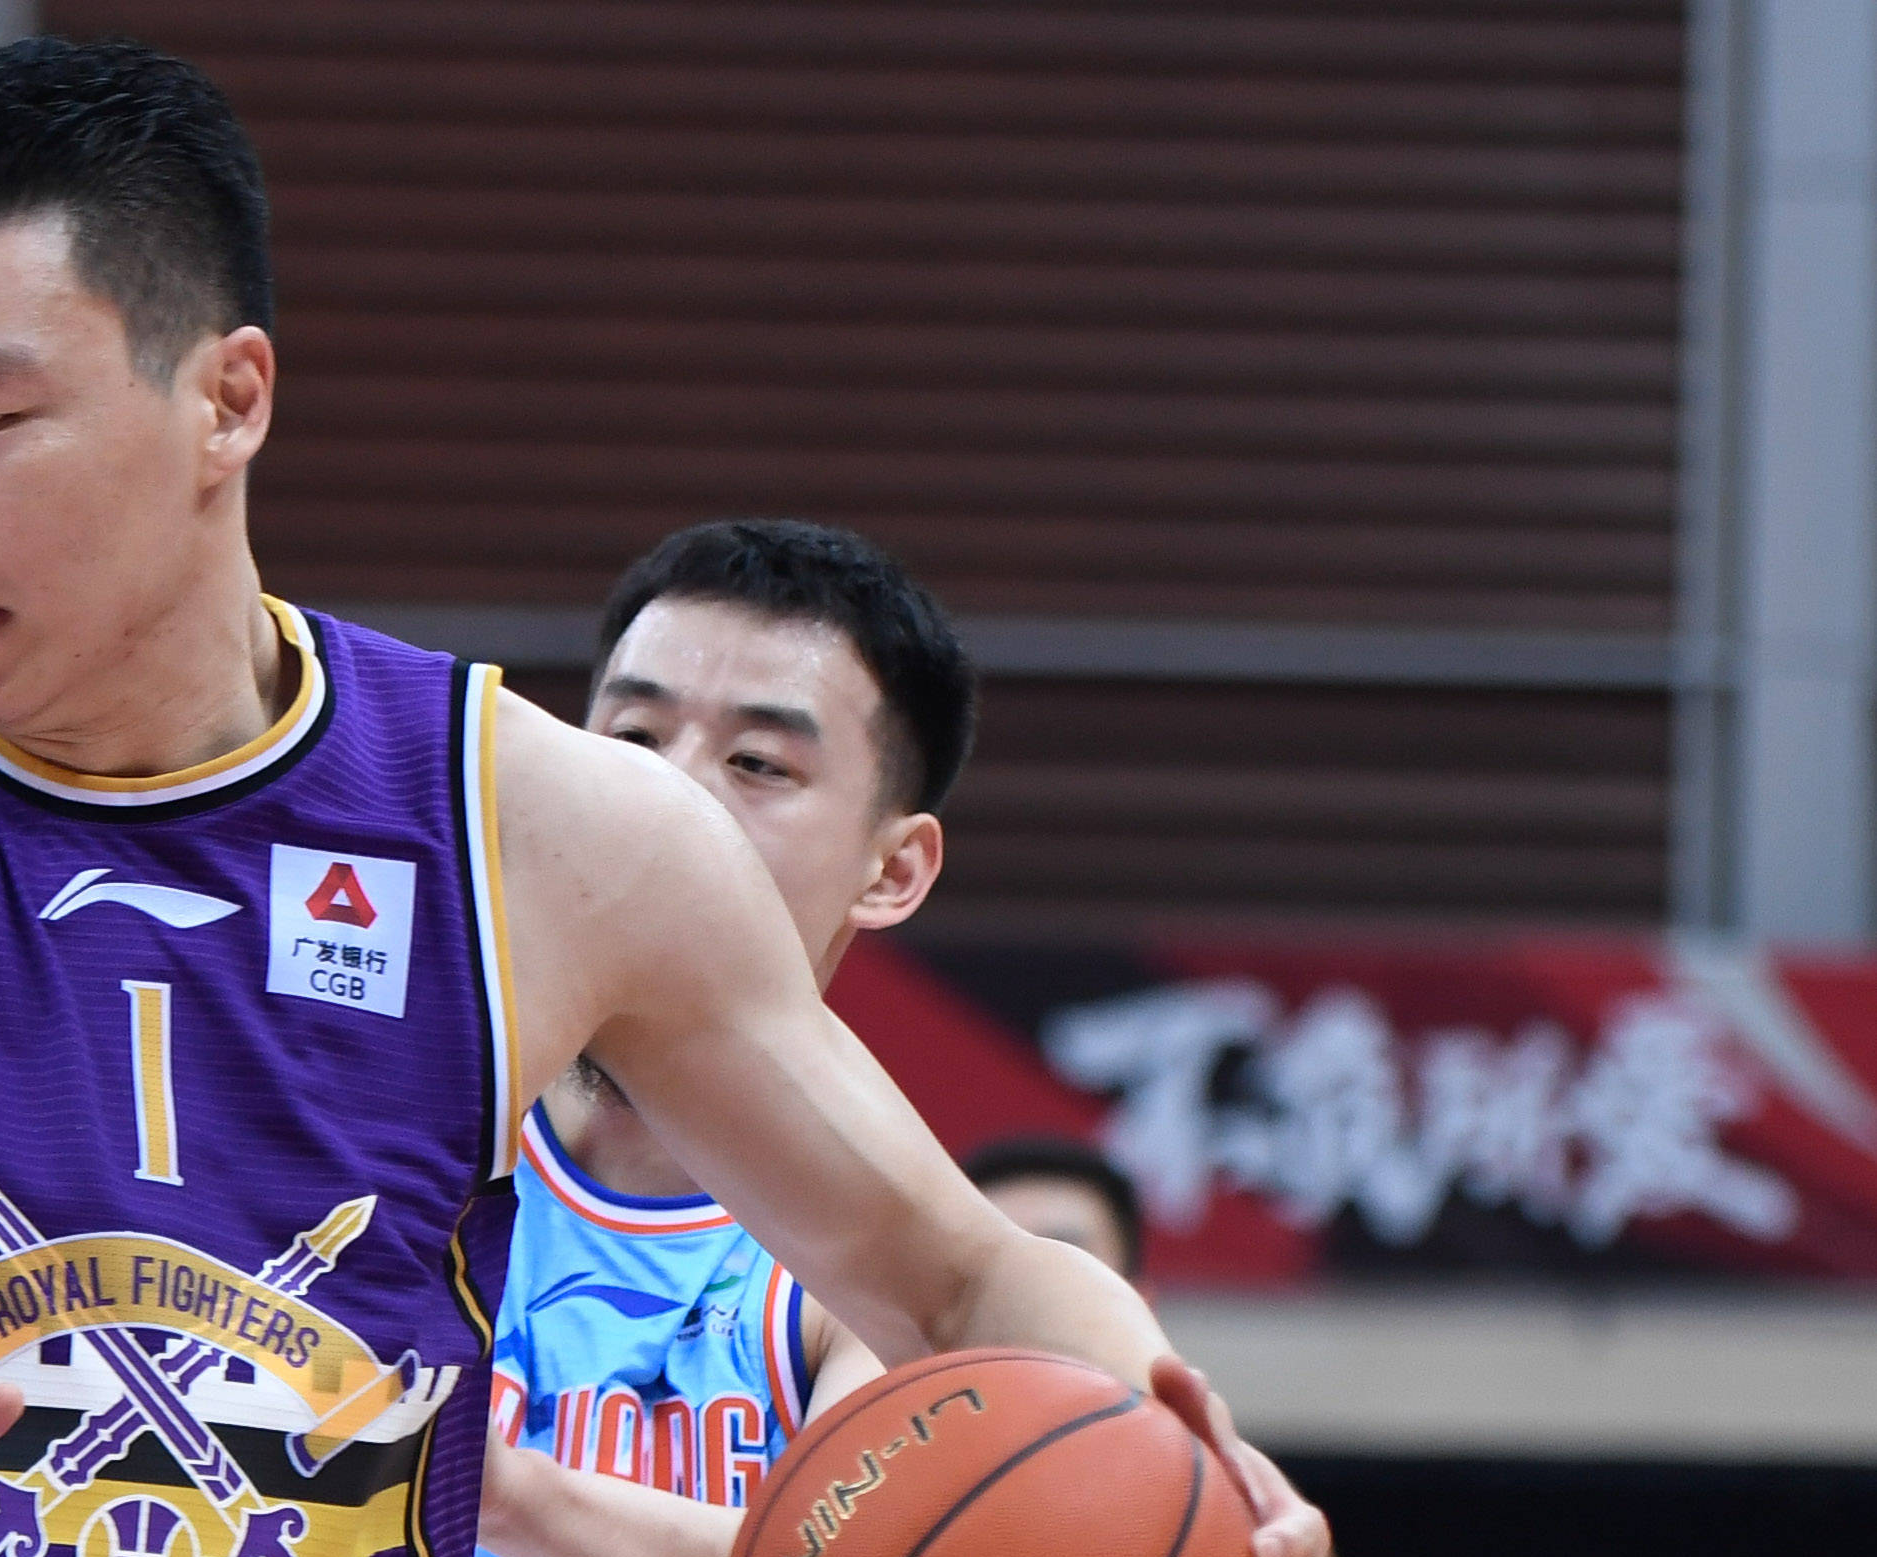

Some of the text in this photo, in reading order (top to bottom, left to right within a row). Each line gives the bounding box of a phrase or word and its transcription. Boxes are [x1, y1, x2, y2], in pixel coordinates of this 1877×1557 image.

[291, 936, 388, 976] 广发银行
[309, 968, 366, 1001] CGB
[120, 979, 185, 1187] 1
[131, 1255, 321, 1369] FIGHTERS
